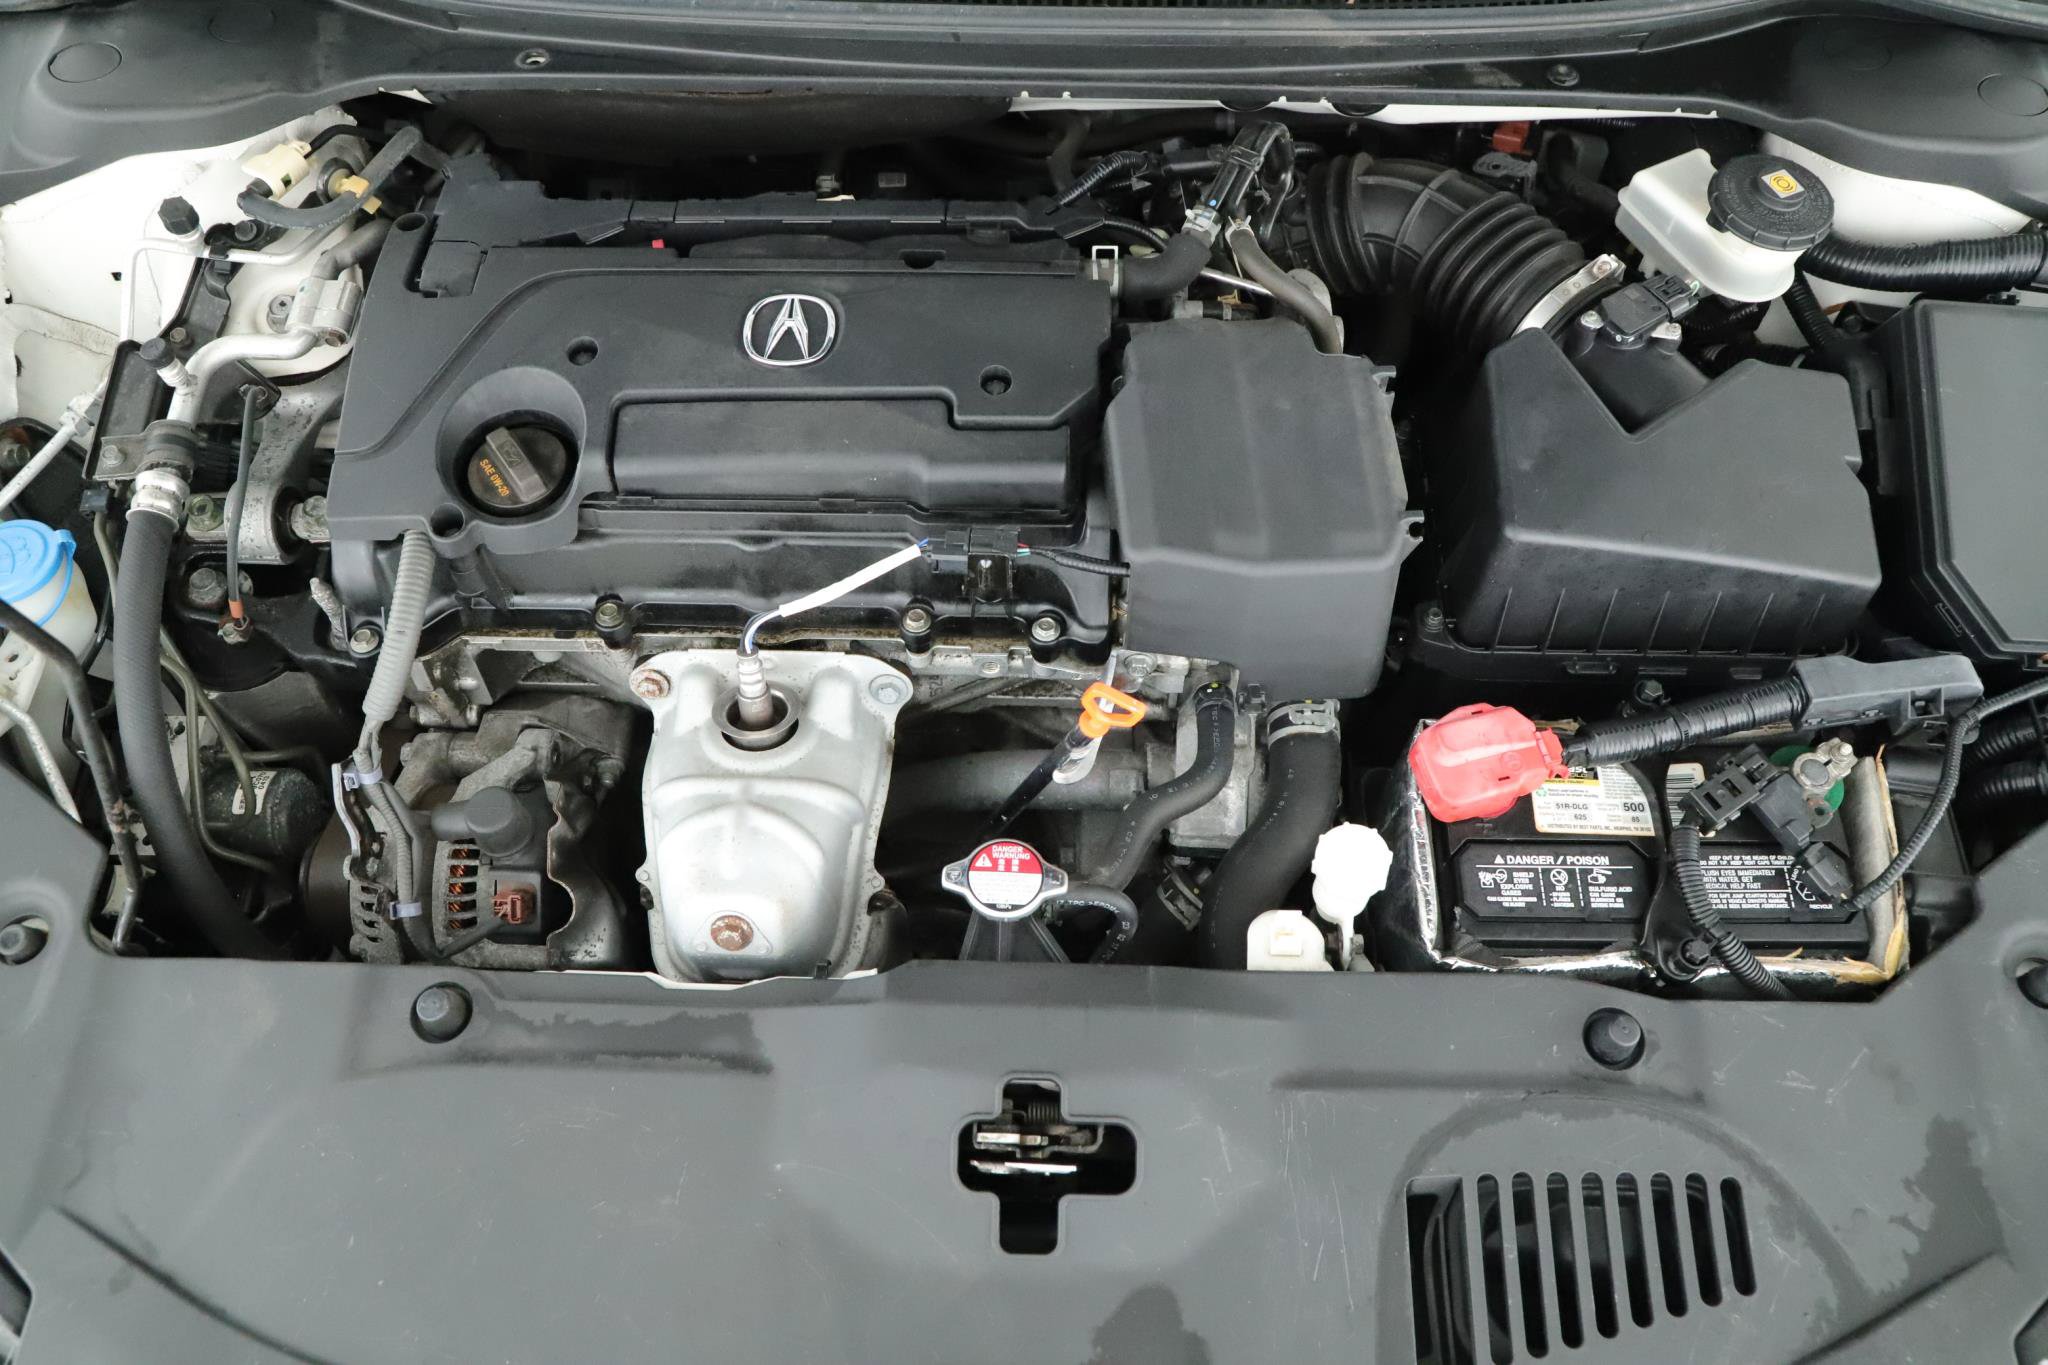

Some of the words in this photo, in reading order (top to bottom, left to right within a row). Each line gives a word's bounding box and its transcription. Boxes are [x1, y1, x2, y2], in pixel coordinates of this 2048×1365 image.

[479, 458, 496, 476] SAE
[489, 471, 511, 497] 0W-20
[1623, 802, 1645, 812] 500
[1573, 813, 1588, 821] 625
[992, 845, 1024, 853] DANGER
[992, 852, 1030, 860] WARNUNG
[1506, 855, 1554, 865] DANGER
[1556, 855, 1564, 865] /
[1567, 856, 1609, 865] POISON
